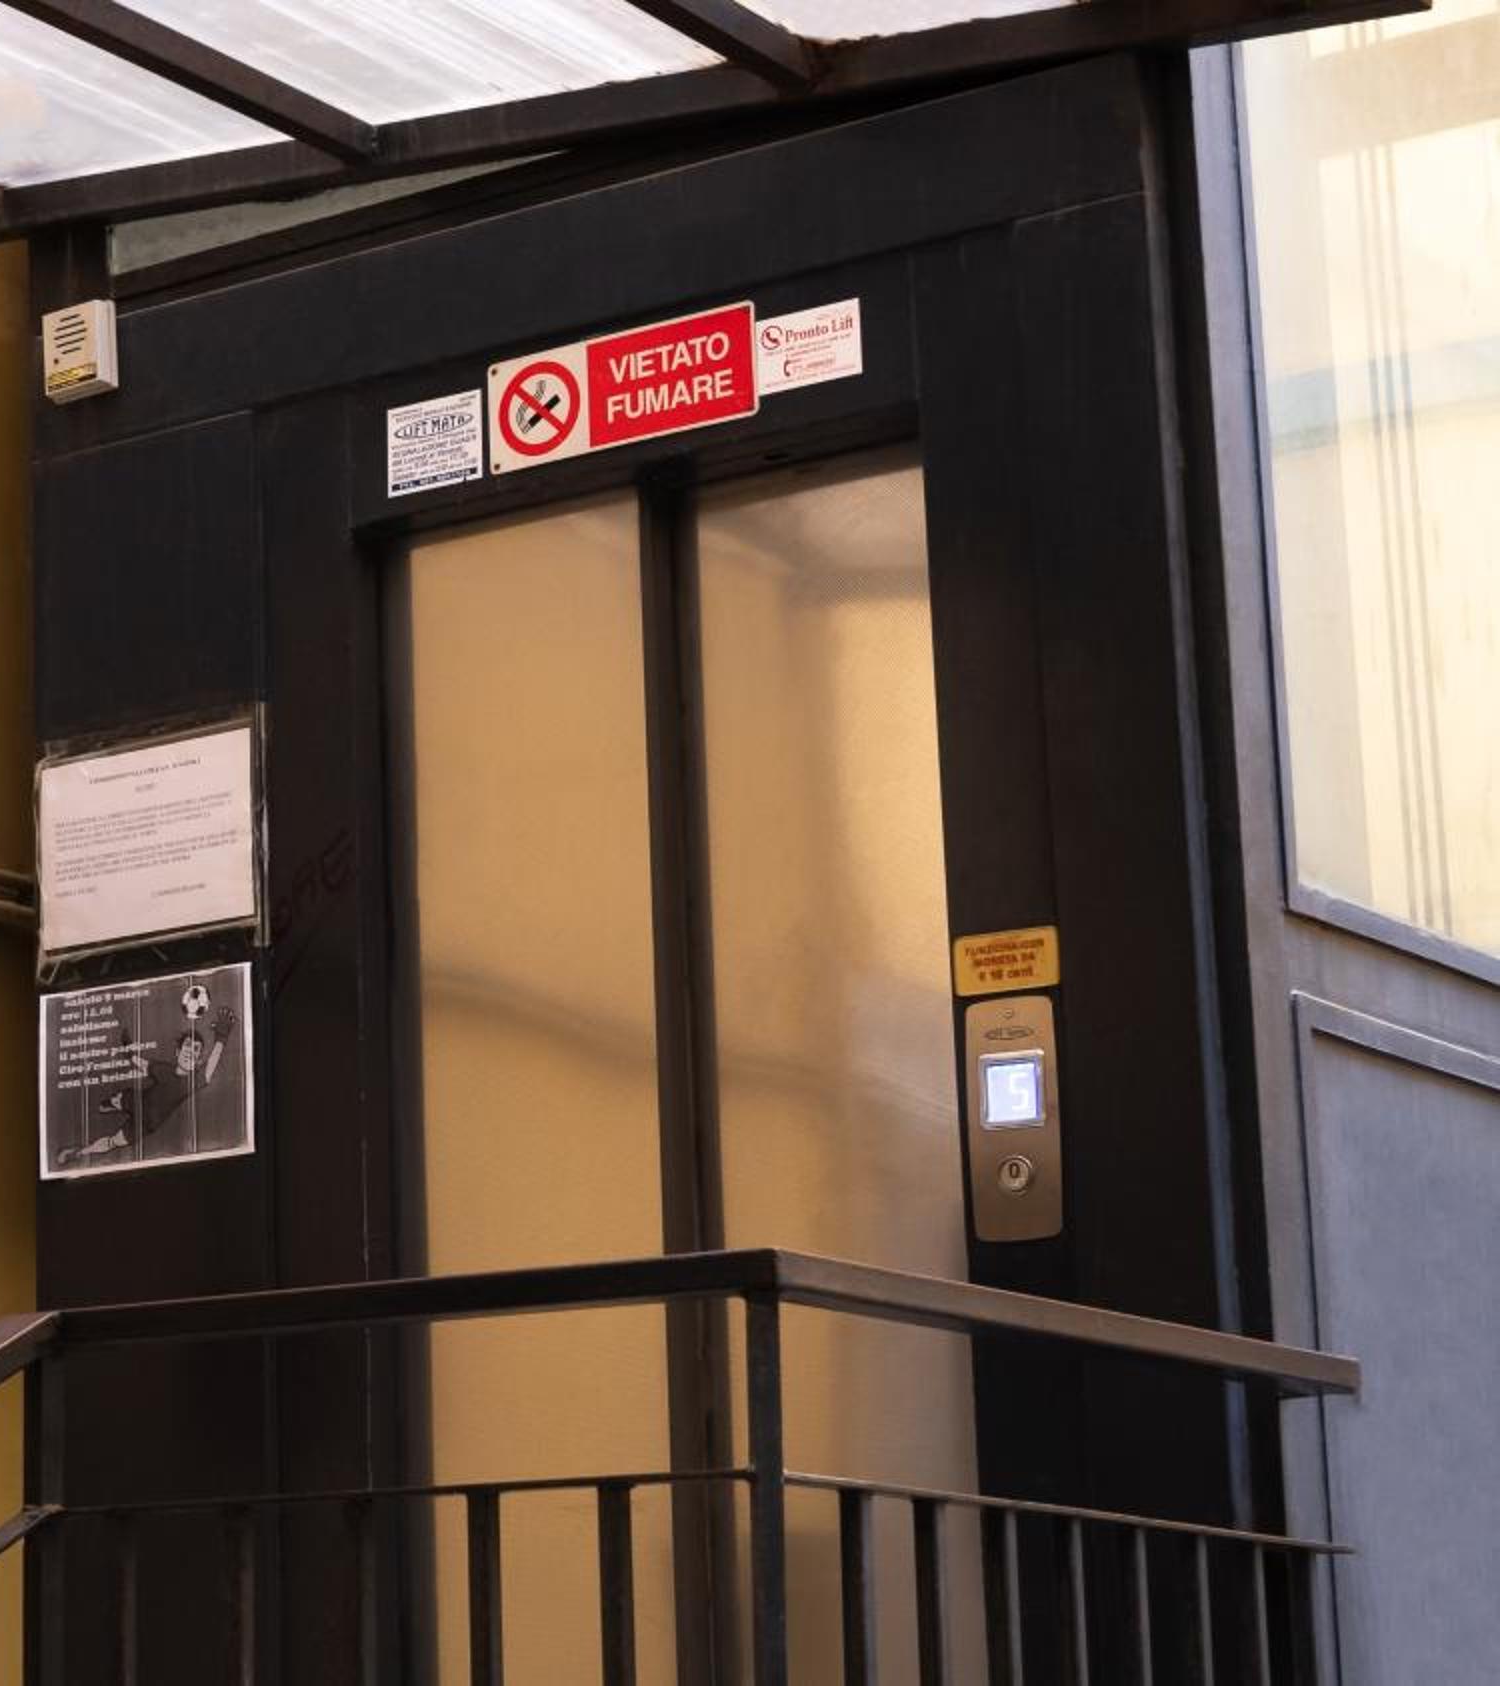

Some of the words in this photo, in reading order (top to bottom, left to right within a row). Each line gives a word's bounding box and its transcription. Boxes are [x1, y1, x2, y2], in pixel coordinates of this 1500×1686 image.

[785, 324, 829, 342] Pronto
[831, 313, 854, 333] Lift
[608, 331, 730, 385] VIETATO
[606, 368, 735, 425] FUMARE
